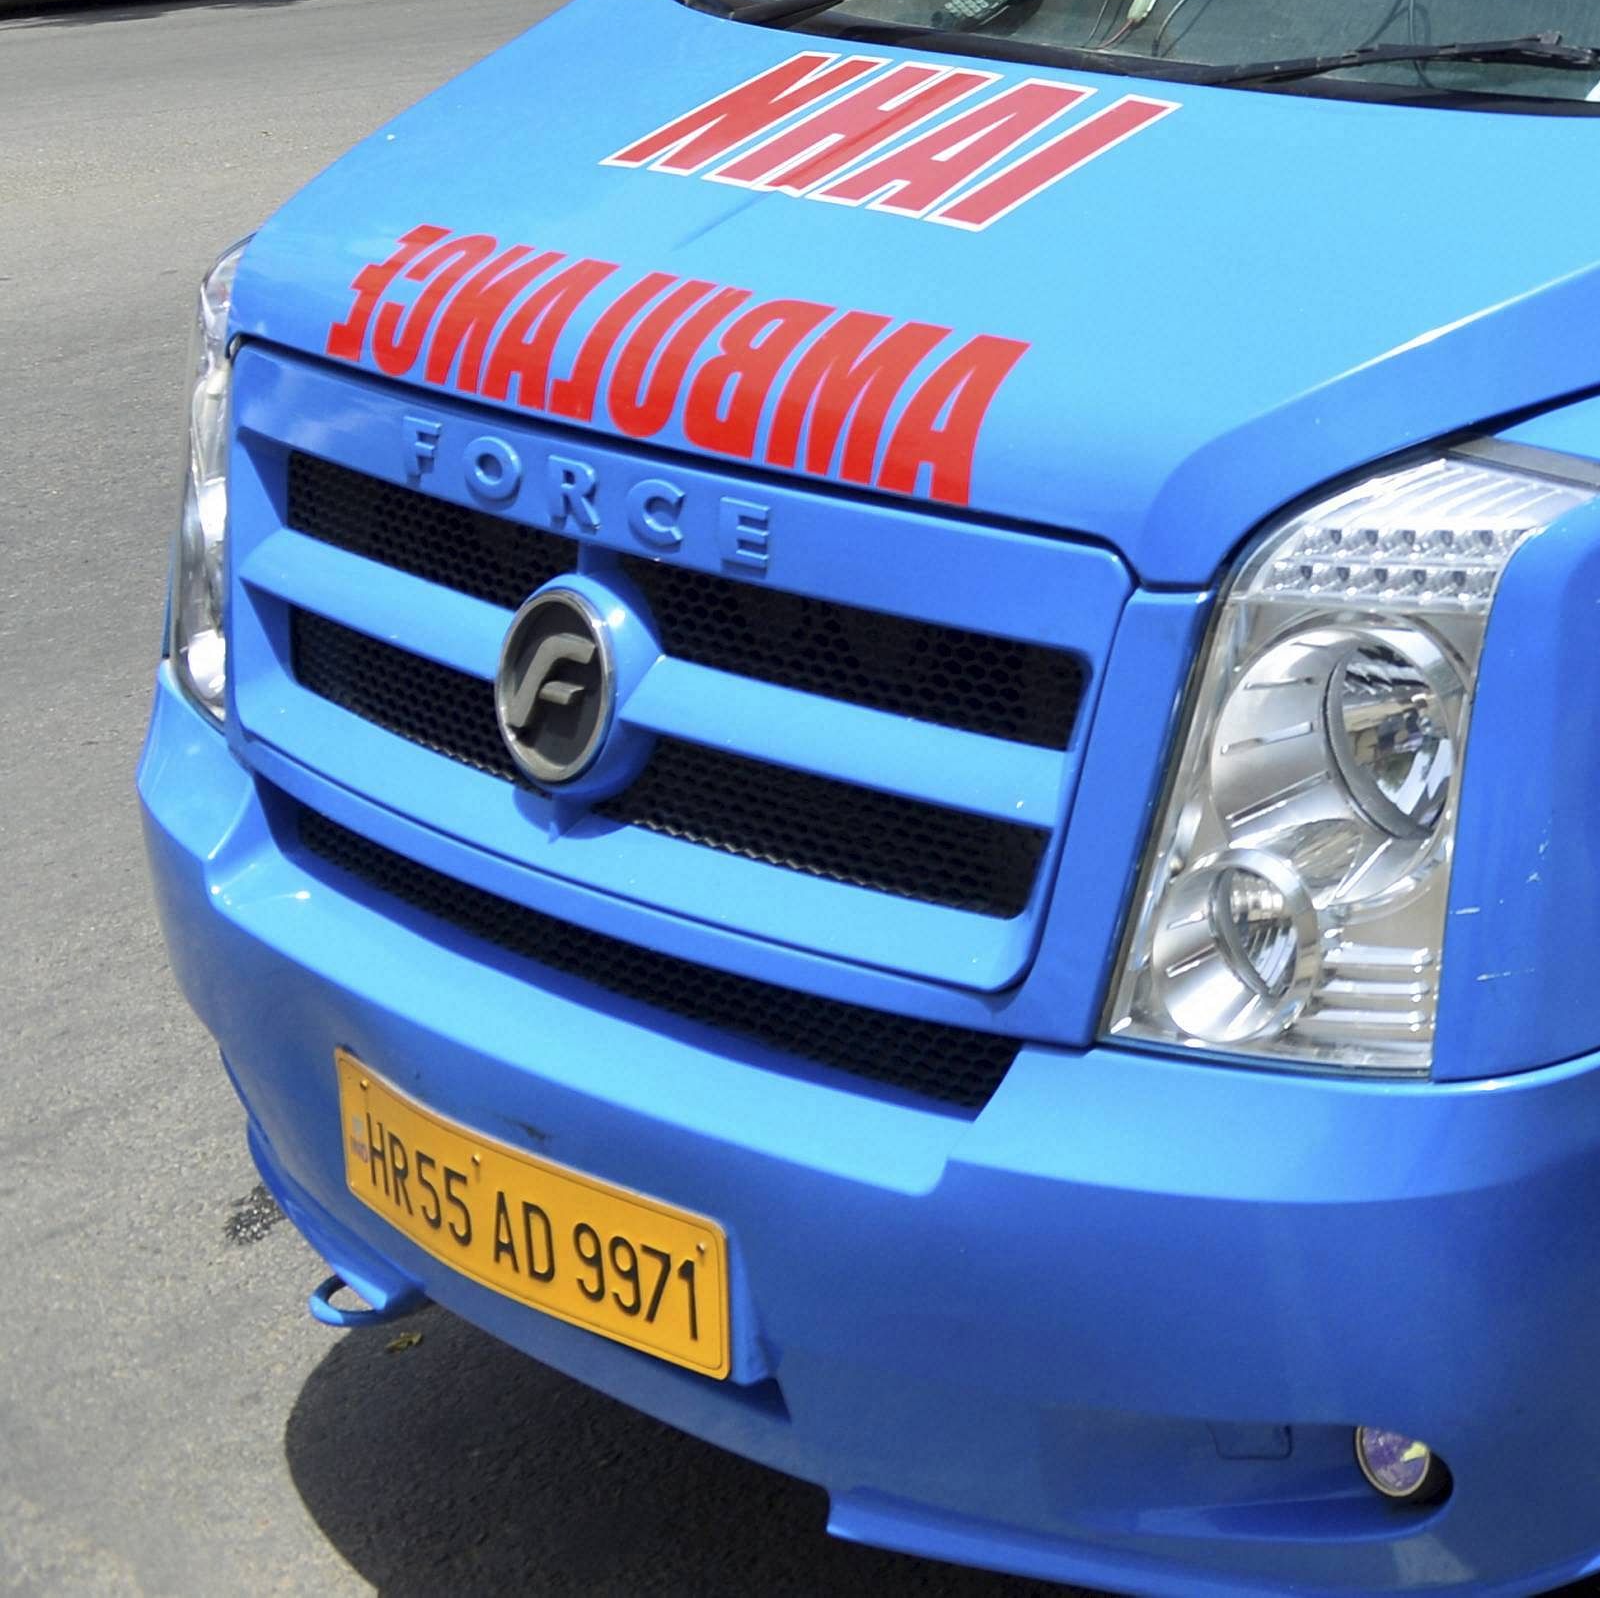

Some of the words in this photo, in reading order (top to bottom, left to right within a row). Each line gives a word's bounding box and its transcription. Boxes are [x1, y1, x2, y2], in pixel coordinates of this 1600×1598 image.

[402, 414, 772, 575] FORCE
[365, 1111, 473, 1247] HR55
[493, 1190, 556, 1284] AD
[572, 1222, 699, 1342] 9971
